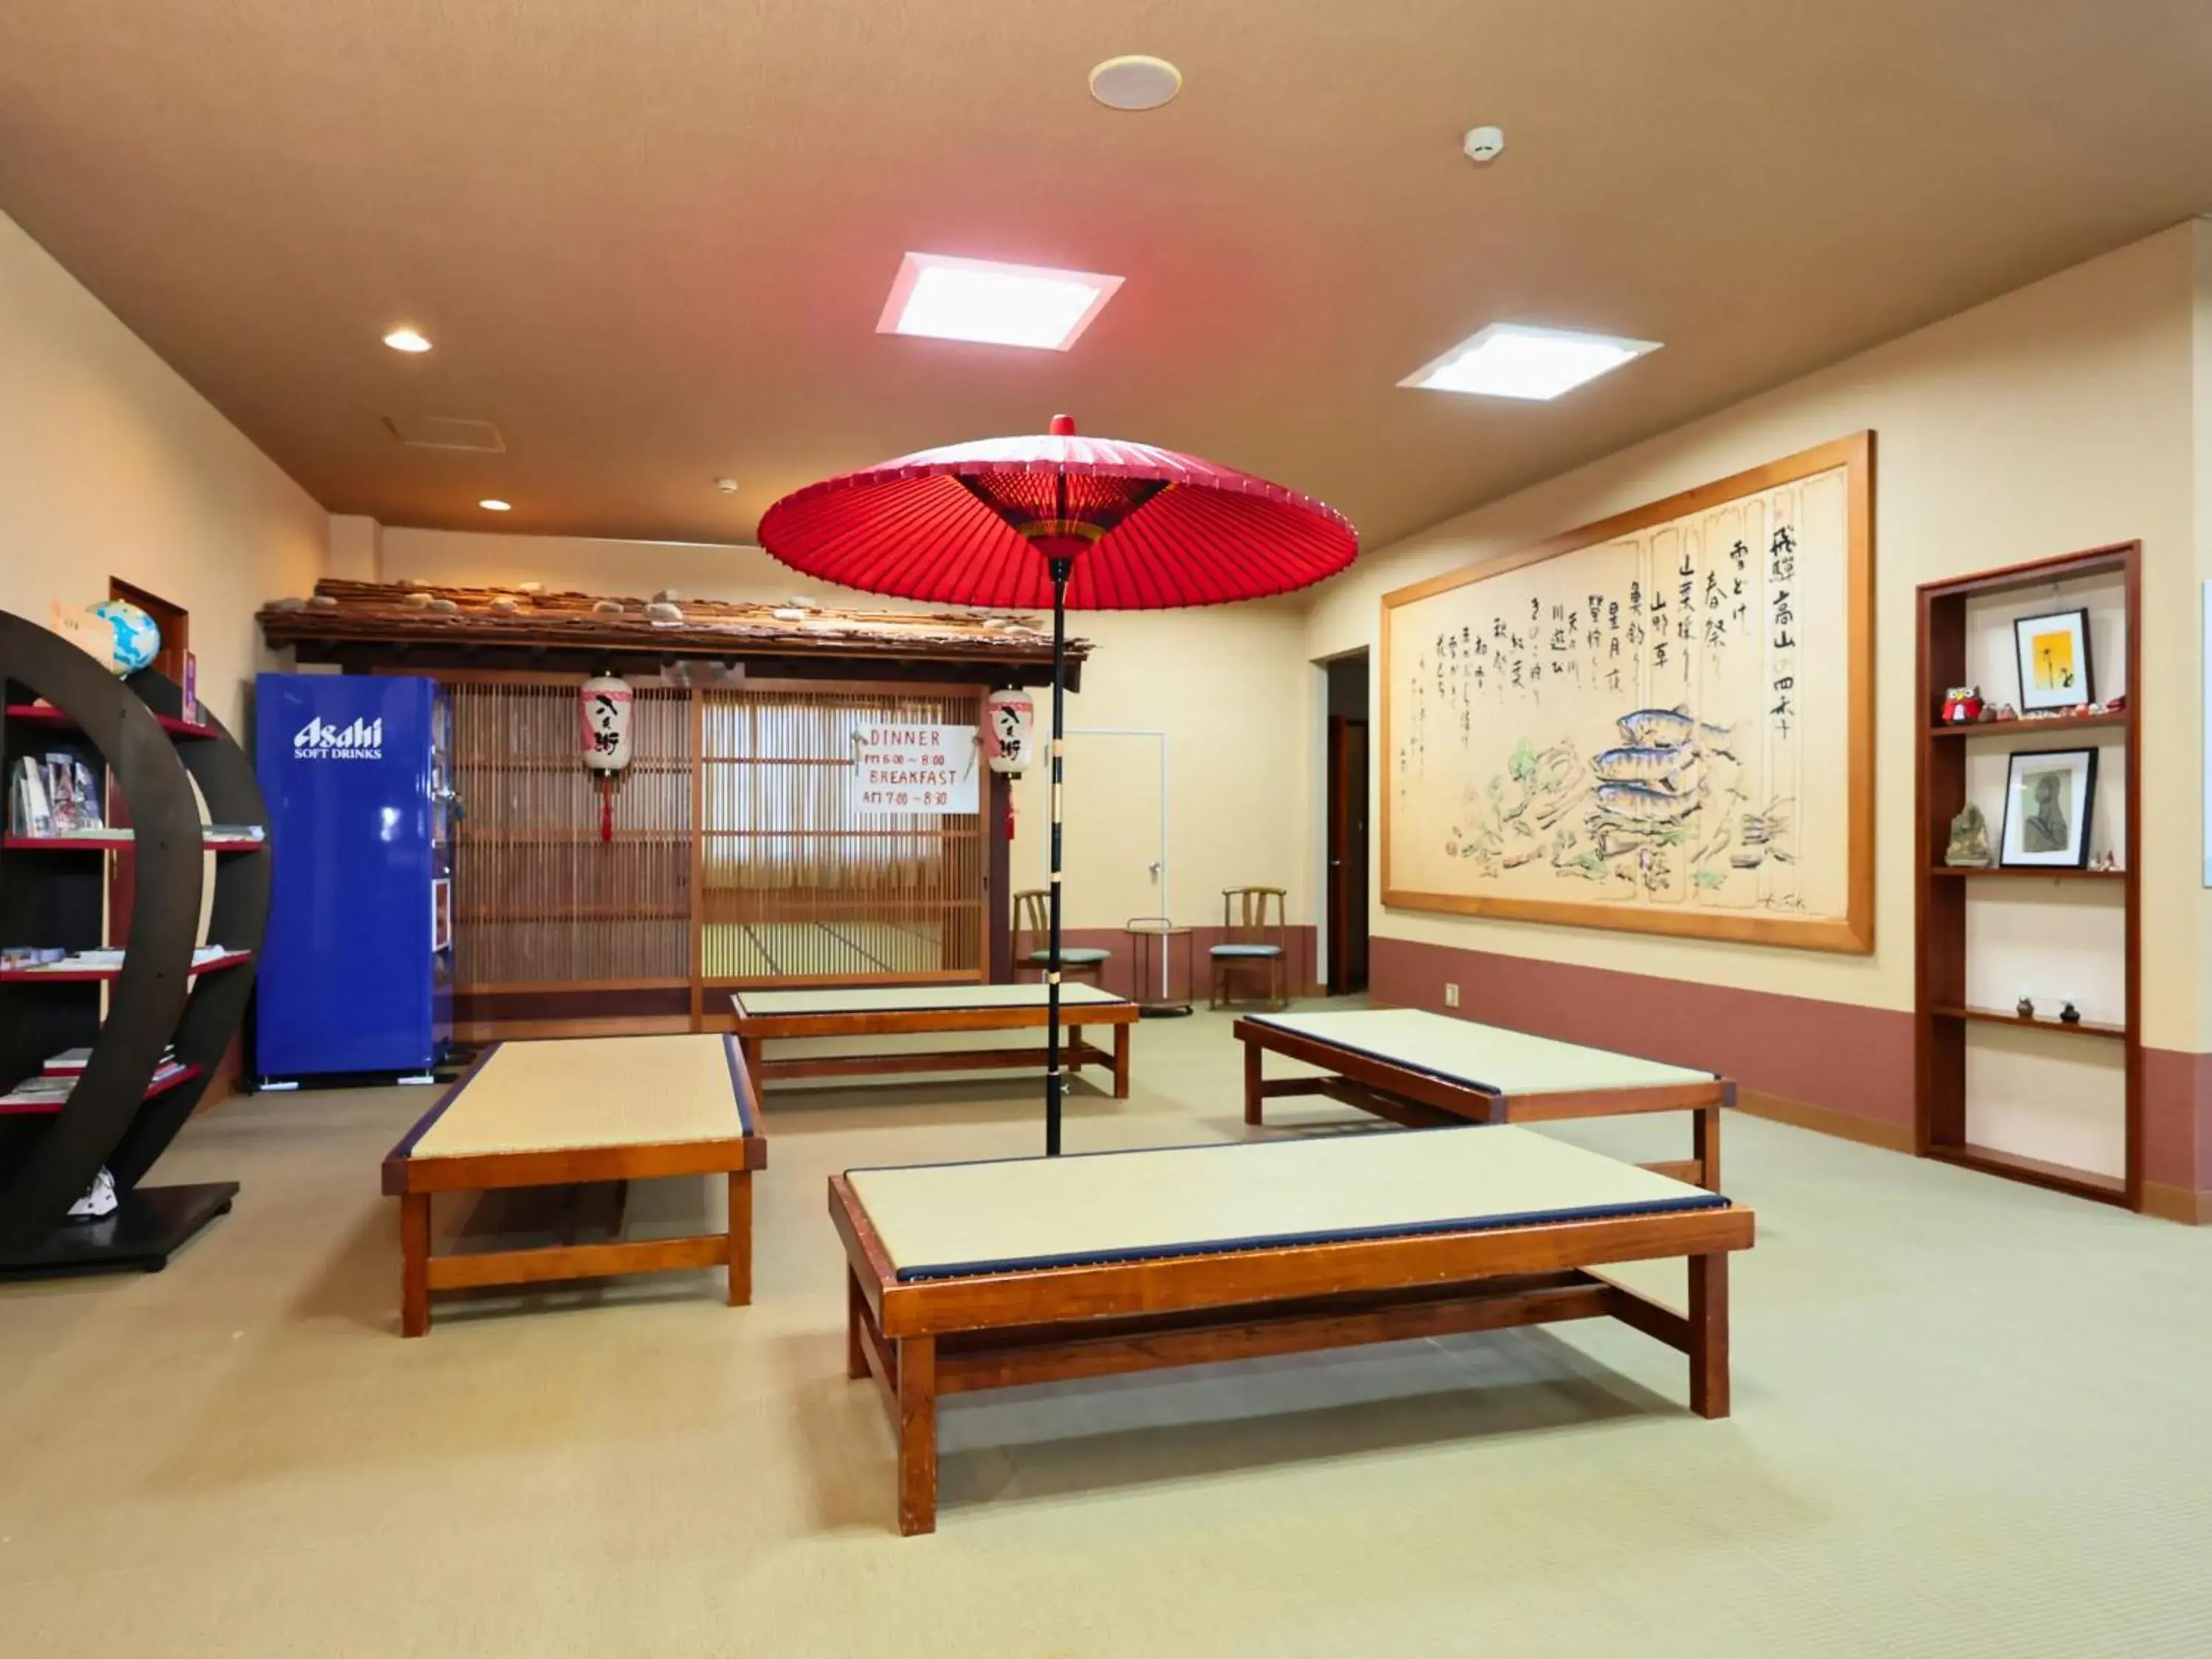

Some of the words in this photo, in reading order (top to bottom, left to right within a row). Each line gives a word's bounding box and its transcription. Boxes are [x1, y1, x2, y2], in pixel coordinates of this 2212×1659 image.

[293, 716, 383, 748] Asahi
[870, 729, 941, 746] DINNER
[294, 748, 329, 759] SOFT
[331, 748, 382, 759] DRINKS
[869, 770, 957, 786] BREAKFAST
